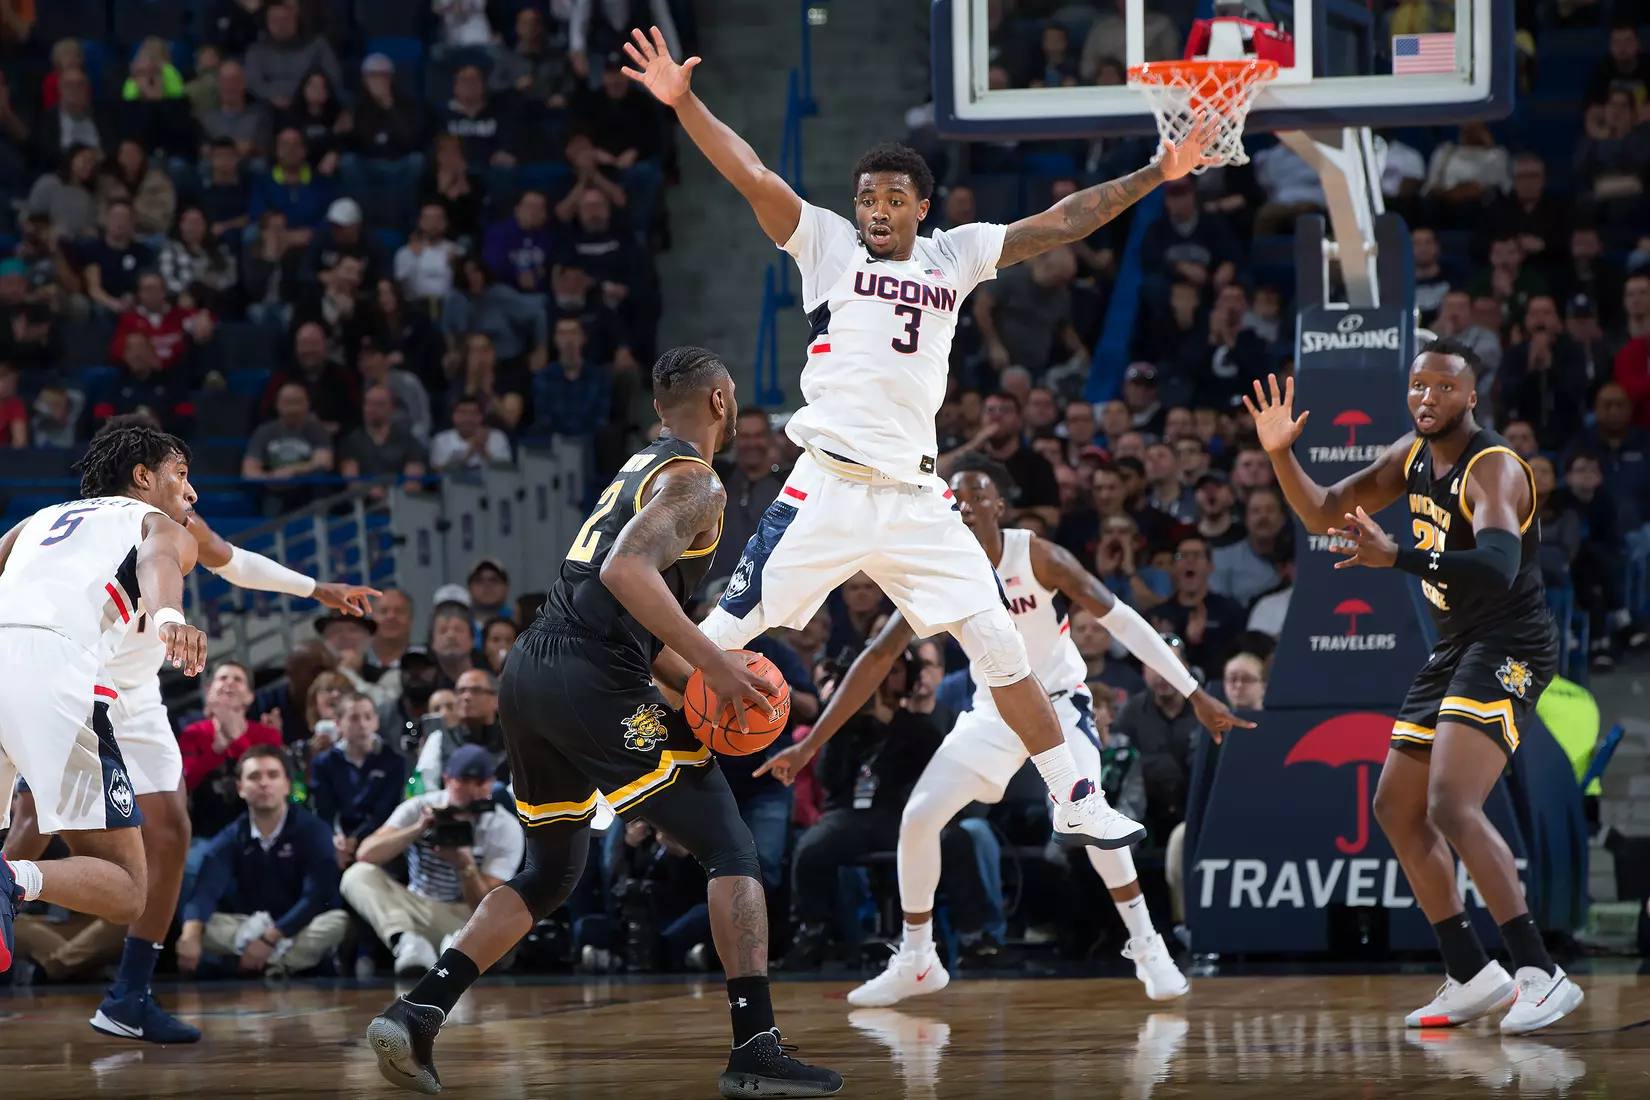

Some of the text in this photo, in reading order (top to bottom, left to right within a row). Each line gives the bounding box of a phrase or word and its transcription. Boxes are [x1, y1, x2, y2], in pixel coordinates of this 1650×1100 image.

[854, 271, 957, 312] UCONN
[891, 304, 922, 355] 3
[1302, 327, 1399, 354] SPALDING
[1309, 445, 1391, 462] TRAVELER
[39, 507, 100, 546] 5
[565, 479, 626, 563] 2
[1309, 633, 1396, 651] TRAVELERS
[1195, 858, 1527, 908] TRAVELR
